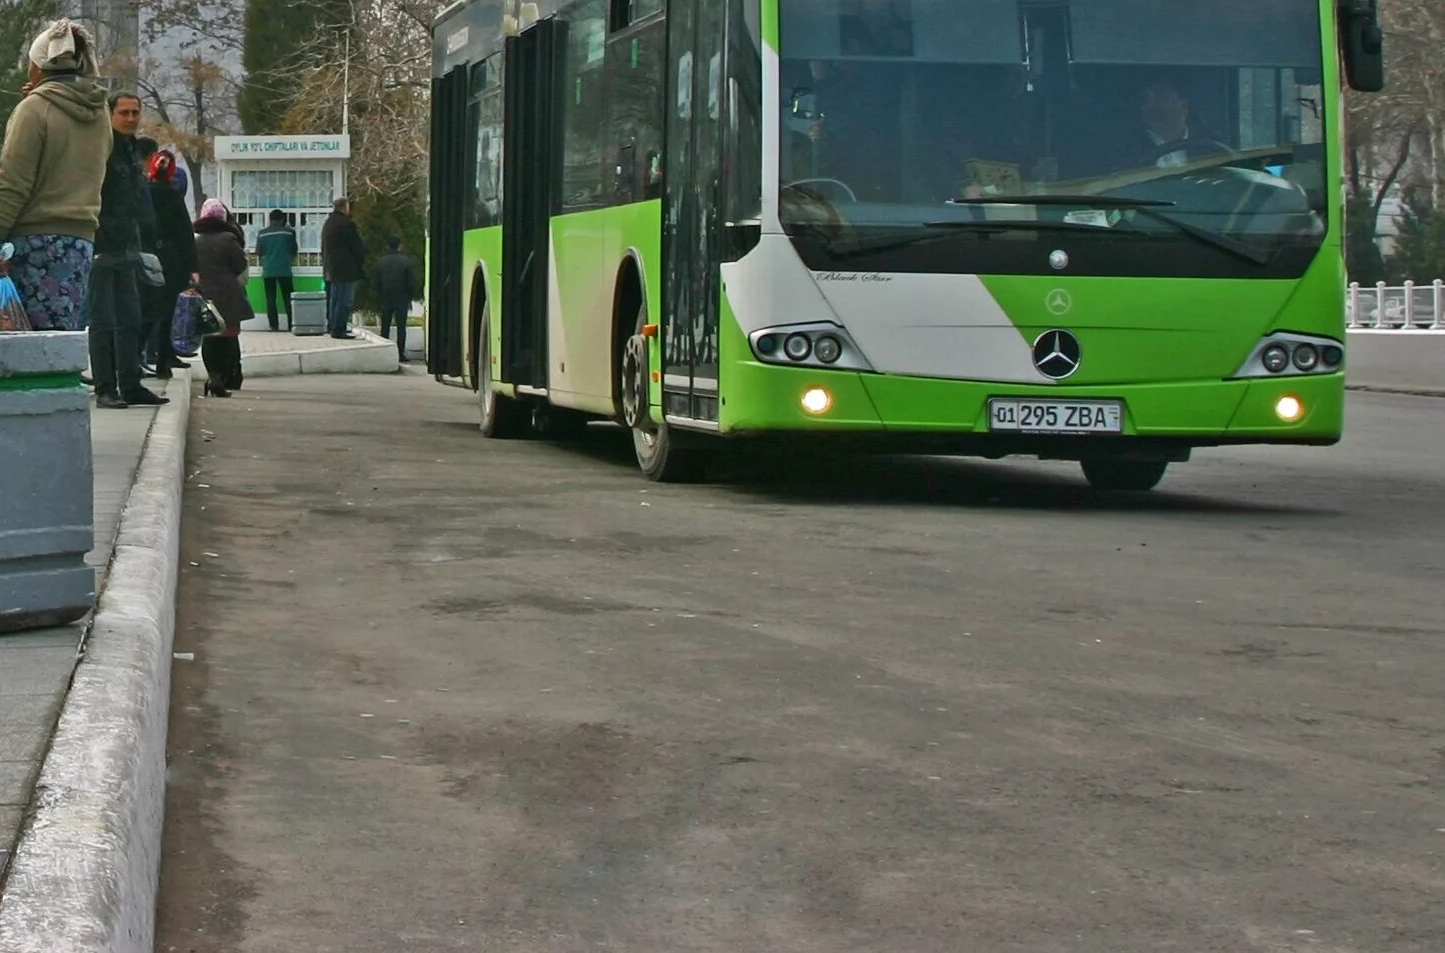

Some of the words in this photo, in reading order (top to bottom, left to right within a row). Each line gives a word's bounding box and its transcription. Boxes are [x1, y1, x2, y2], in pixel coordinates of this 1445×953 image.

[995, 407, 1016, 423] 01
[1020, 406, 1058, 427] 295
[1064, 406, 1107, 427] ZBA
